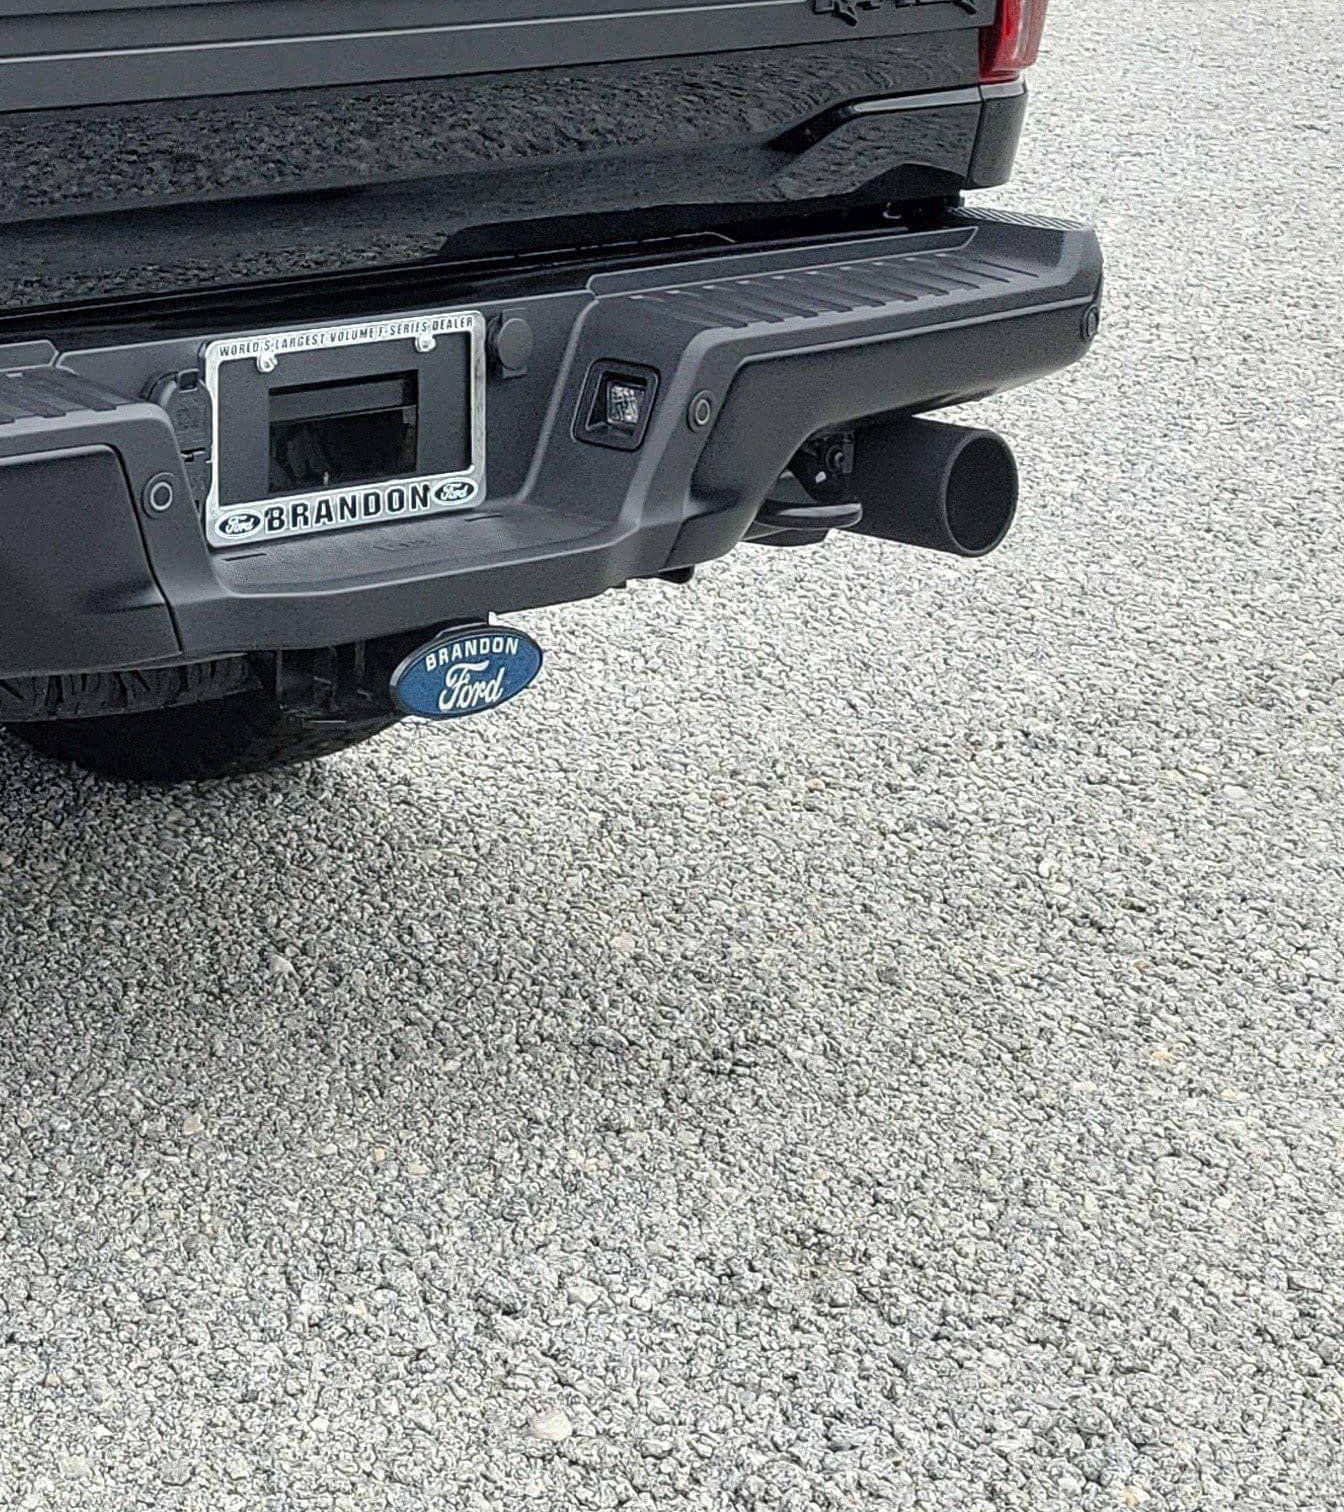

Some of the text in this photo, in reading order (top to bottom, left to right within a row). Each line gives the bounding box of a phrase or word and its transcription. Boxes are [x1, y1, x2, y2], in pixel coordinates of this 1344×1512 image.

[219, 339, 271, 357] WORLDS
[275, 335, 326, 349] LARGEST
[329, 329, 375, 344] VOLUME
[431, 316, 474, 331] DEALER
[224, 481, 472, 535] Ford BRANDON Ford
[425, 637, 519, 671] BRANDON
[438, 660, 506, 711] Ford
